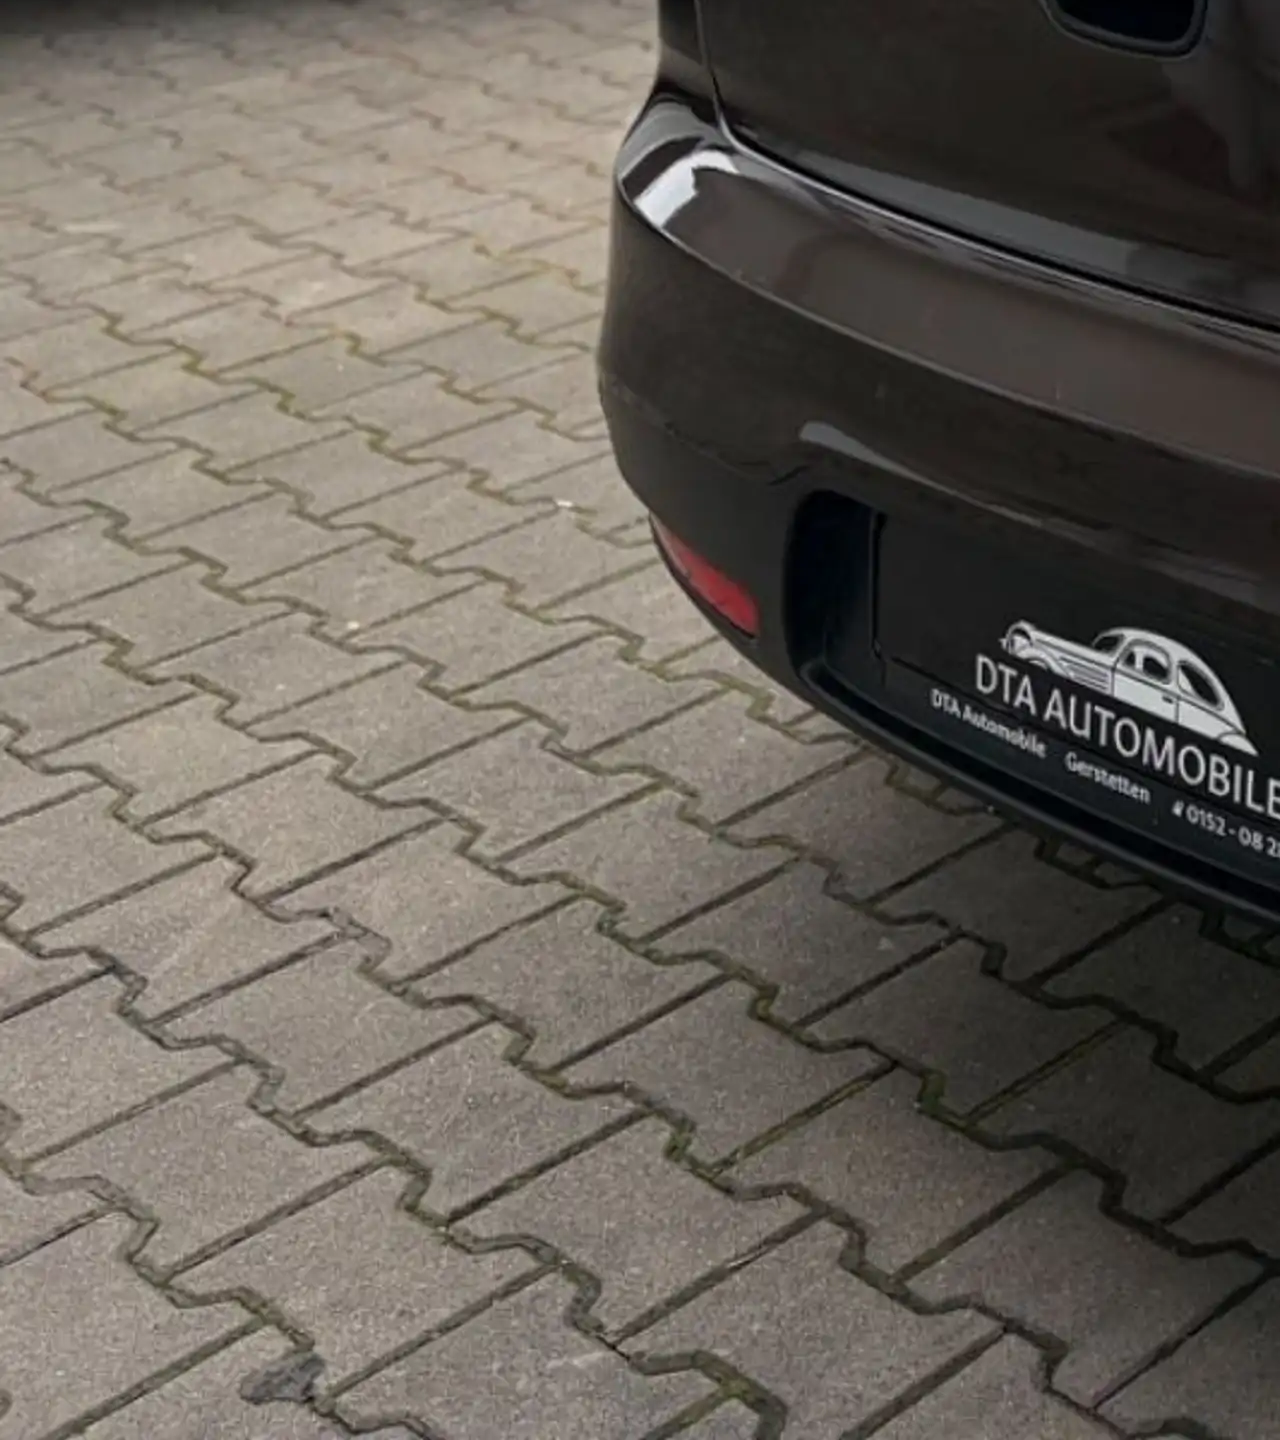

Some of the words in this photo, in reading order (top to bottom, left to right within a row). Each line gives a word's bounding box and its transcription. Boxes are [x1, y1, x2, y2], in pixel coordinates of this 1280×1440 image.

[975, 653, 1037, 716] DTA
[931, 688, 962, 718] DTA
[962, 703, 1046, 758] Automobile
[1186, 804, 1226, 837] 0152
[1237, 825, 1264, 851] 08
